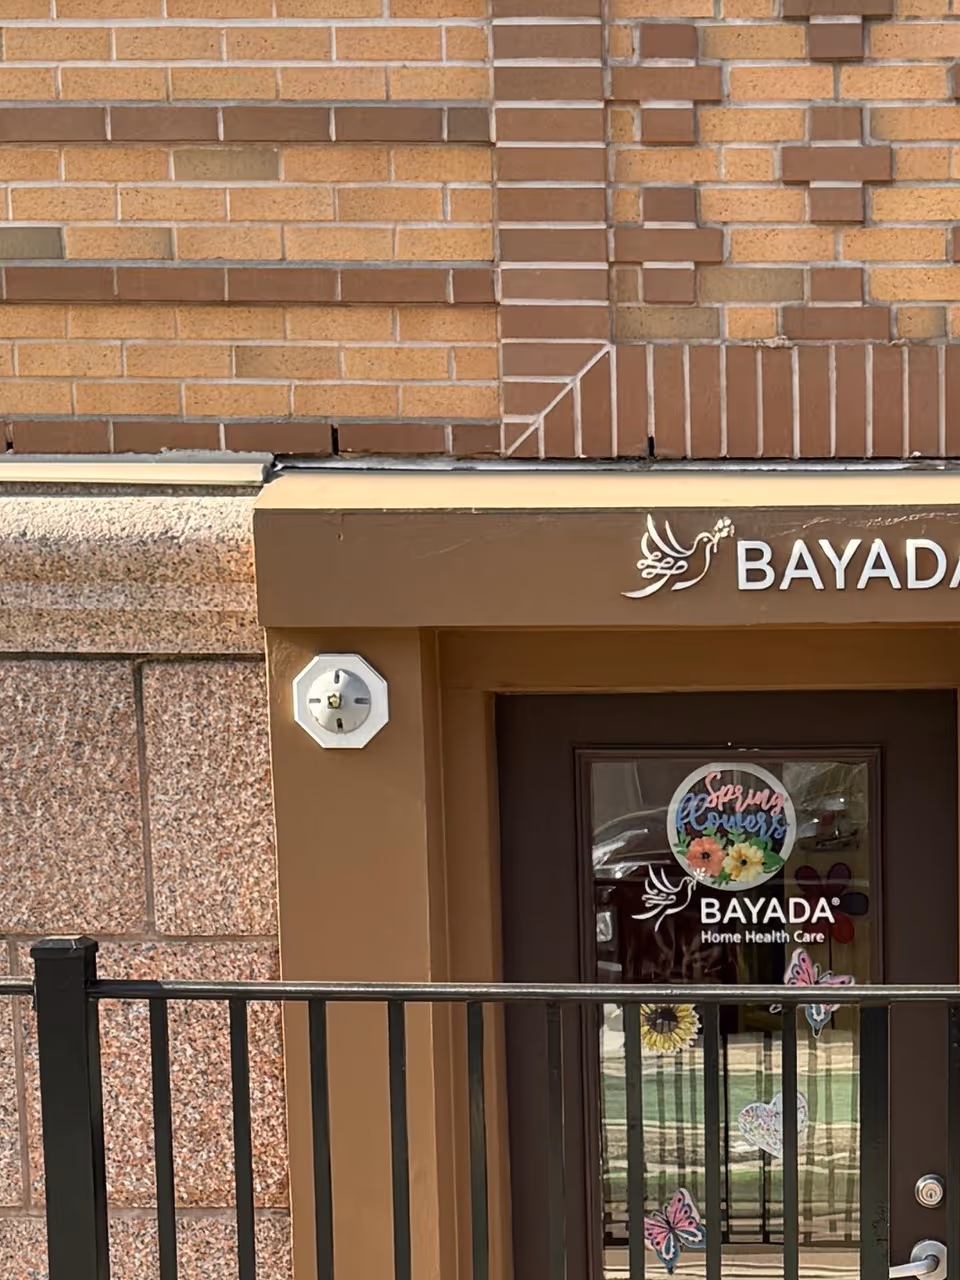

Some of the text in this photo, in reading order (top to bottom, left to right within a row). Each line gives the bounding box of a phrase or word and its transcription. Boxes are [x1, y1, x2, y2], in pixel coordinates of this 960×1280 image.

[705, 771, 785, 817] Spring
[701, 929, 825, 944] Home Health Care
